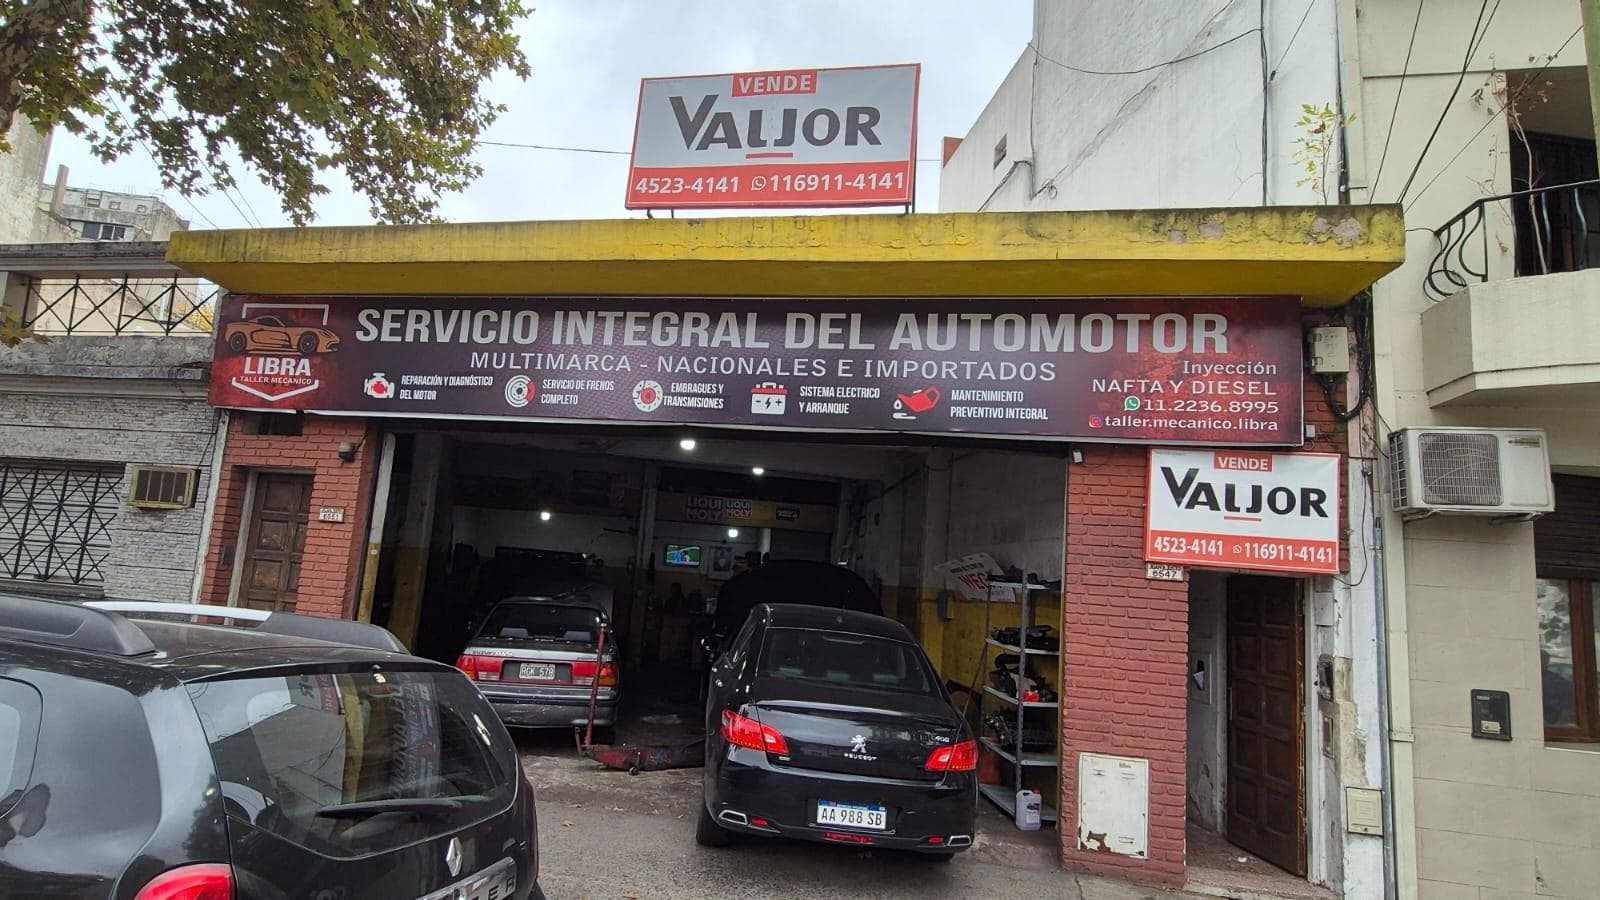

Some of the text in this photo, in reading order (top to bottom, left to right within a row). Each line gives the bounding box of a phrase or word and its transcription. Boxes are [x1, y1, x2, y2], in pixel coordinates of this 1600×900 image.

[738, 74, 812, 94] VENDE
[635, 171, 905, 194] 4523-4141 116911-4141
[355, 308, 1230, 354] SERVICIO INTEGRAL DEL AUTOMOTOR
[243, 356, 311, 377] LIBRA
[470, 352, 632, 372] MULTIMARCA
[657, 355, 827, 377] NACIONALES
[837, 359, 853, 377] E
[864, 359, 1057, 381] IMPORTADOS
[1182, 359, 1277, 376] Inyección
[239, 375, 269, 383] TALLER
[542, 379, 575, 390] SERVICIO
[575, 380, 585, 390] DE
[671, 382, 724, 394] EMBRAGUES Y
[799, 385, 880, 399] SISTEMA ELECTRICO
[1092, 378, 1277, 396] NAFTA Y DIESEL
[400, 389, 437, 401] DEL MOTOR
[541, 393, 578, 405] COMPLETO
[663, 395, 724, 409] TRANSMISIONES
[951, 389, 1024, 402] MANTENIMIENTO
[798, 401, 849, 414] Y ARRANQUE
[950, 405, 1048, 420] PREVENTIVO INTEGRAL
[1143, 399, 1279, 414] 11.2236.8995
[1104, 414, 1279, 431] taller.mecanico.libra
[1217, 456, 1269, 471] VENDE
[1153, 536, 1333, 563] 4523-4141 116911-4141
[821, 807, 882, 826] AA 988 SB
